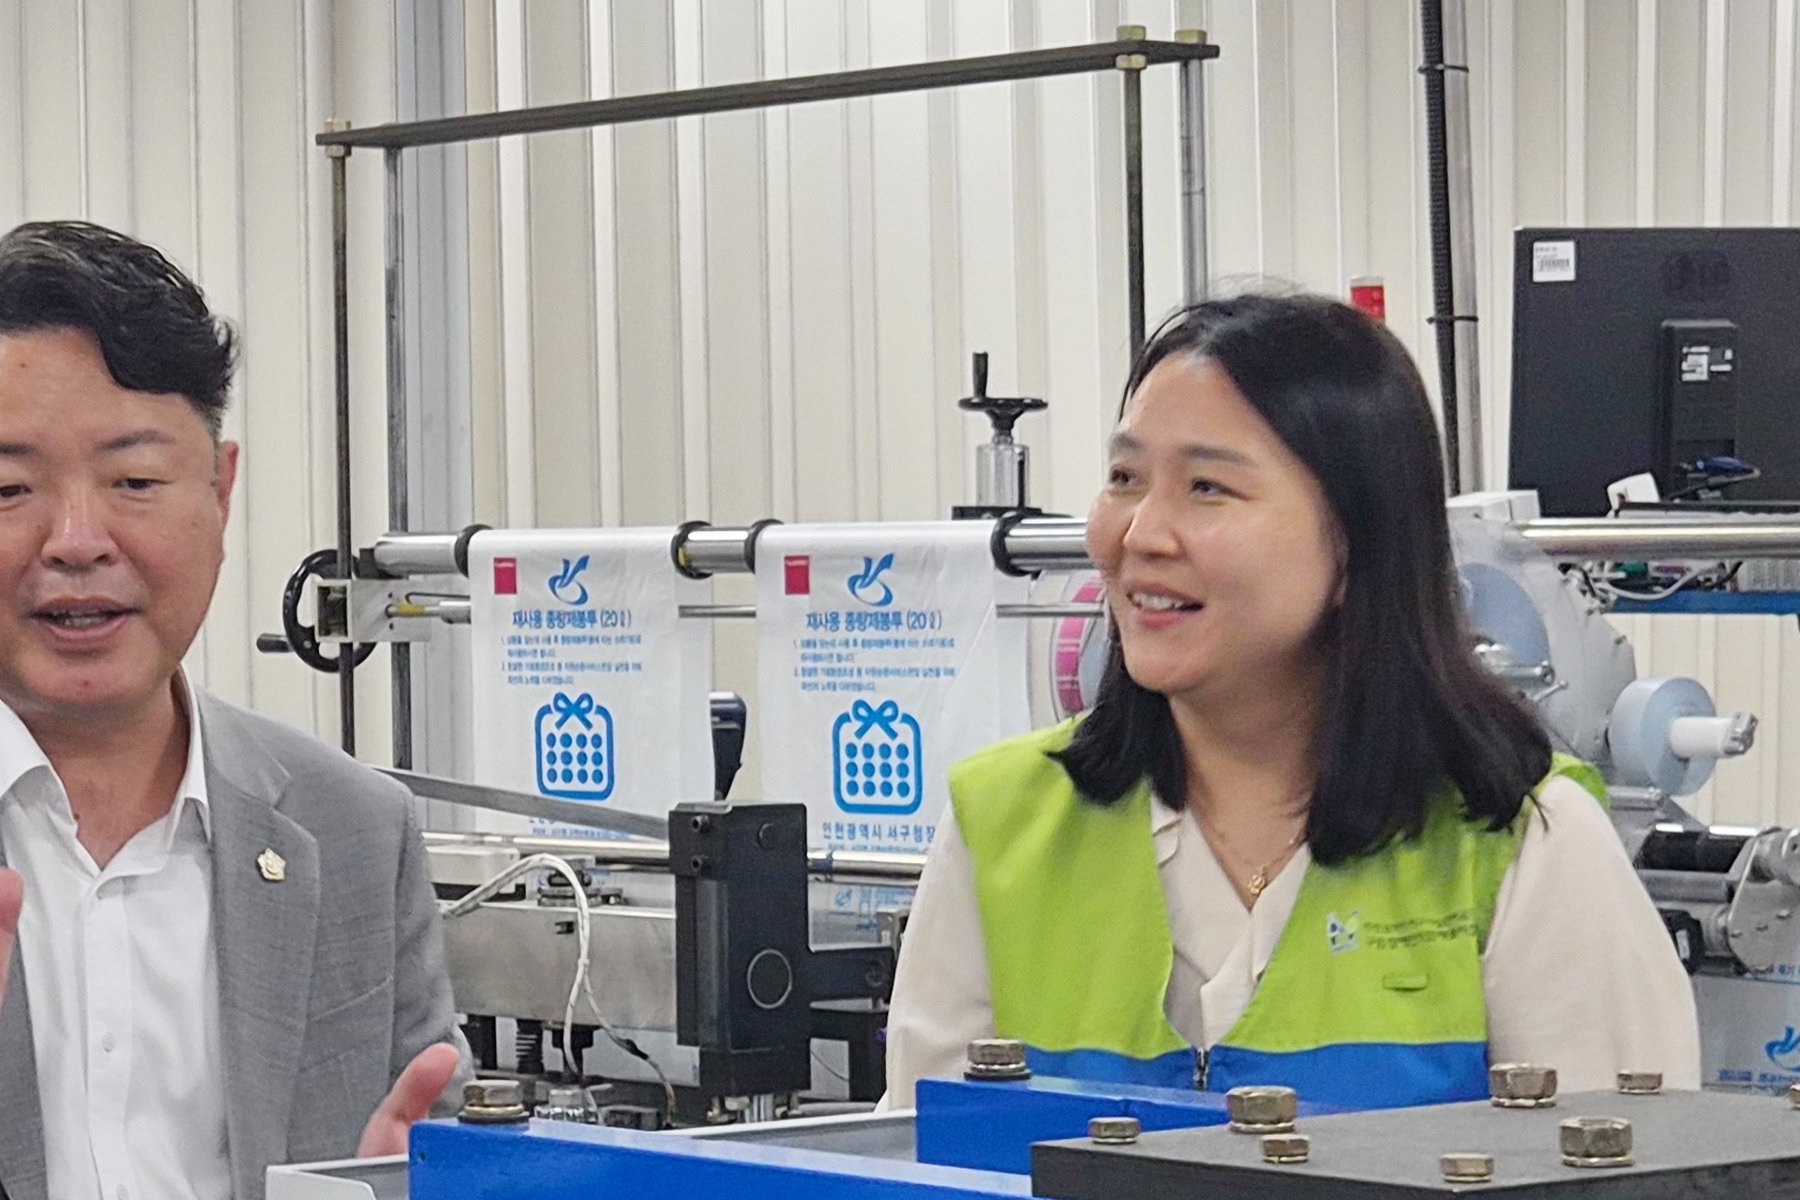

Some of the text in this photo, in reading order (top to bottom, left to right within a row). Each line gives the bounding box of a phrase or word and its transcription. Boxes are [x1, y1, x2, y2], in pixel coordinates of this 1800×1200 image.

[512, 609, 543, 629] 재사용
[806, 611, 840, 632] 재사용
[822, 822, 882, 841] 인천광역시
